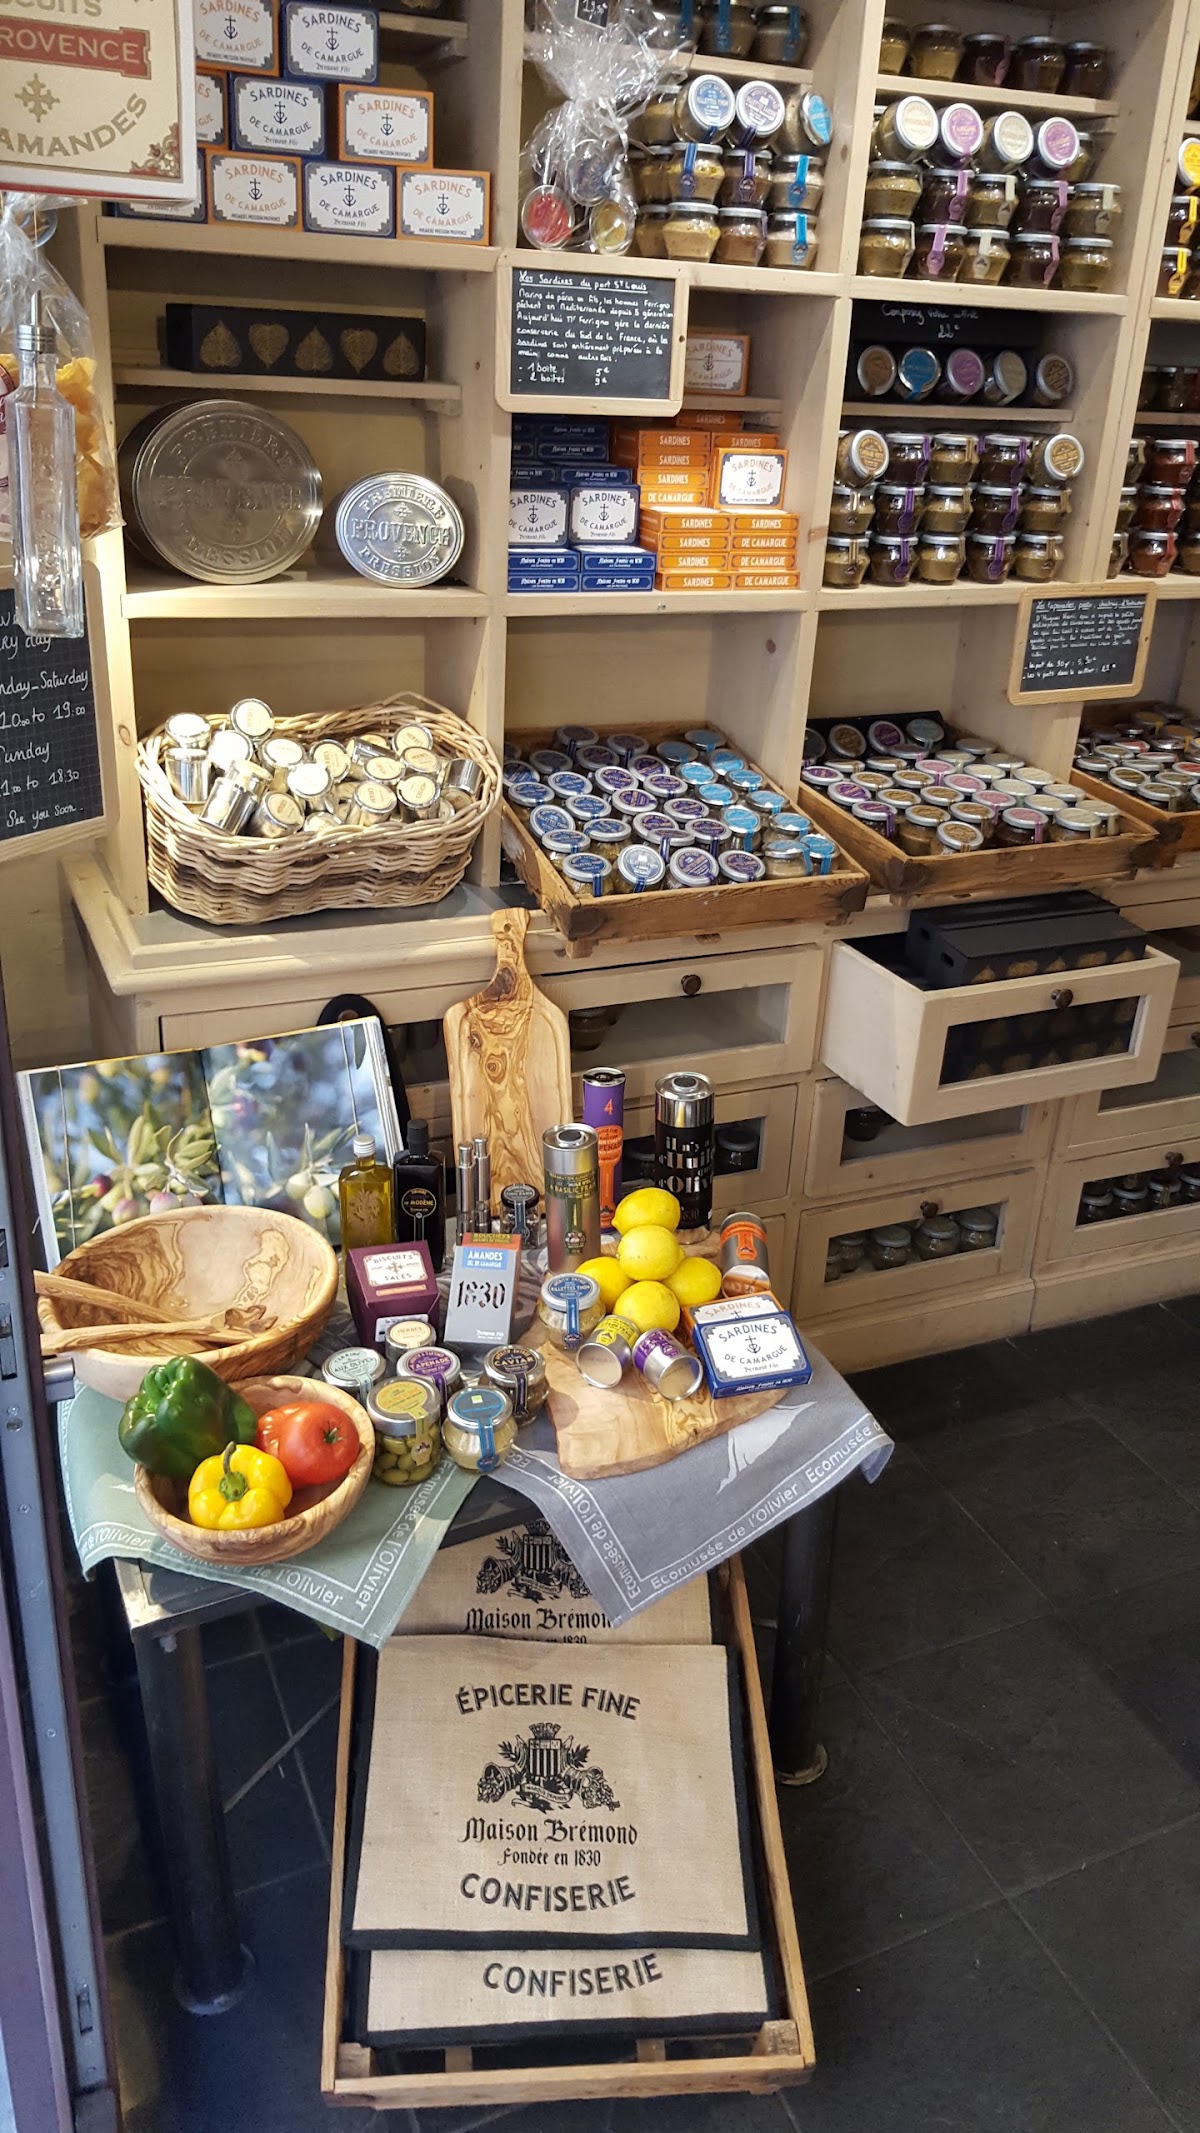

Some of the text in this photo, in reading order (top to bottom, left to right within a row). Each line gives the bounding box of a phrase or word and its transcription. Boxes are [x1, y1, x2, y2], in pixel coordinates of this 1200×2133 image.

[200, 0, 261, 23] SARDINES
[302, 12, 362, 34] SARDINES
[199, 30, 263, 52] DE CAMARGUE
[301, 41, 365, 63] DE CAMARGUE
[250, 87, 309, 107] SARDINES
[358, 100, 416, 120] SARDINES
[249, 115, 312, 137] DE CAMARGUE
[356, 128, 418, 149] DE CAMARGUE
[225, 164, 284, 184] SARDINES
[320, 171, 378, 190] SARDINES
[414, 180, 472, 198] SARDINES
[224, 193, 287, 213] DE CAMARGUE
[319, 199, 380, 219] DE CAMARGUE
[412, 208, 474, 227] DE CAMARGUE
[659, 435, 691, 446] SARDINES
[731, 437, 762, 448] SARDINES
[659, 455, 690, 466] SARDINES
[731, 459, 774, 473] SARDINES
[657, 473, 689, 485] SARDINES
[510, 494, 558, 509] SARDINES
[581, 492, 627, 507] SARDINES
[648, 492, 695, 503] DE CAMARGUE
[351, 518, 451, 547] PROVENCE
[518, 519, 558, 533] CAMARGUE
[580, 516, 628, 531] DE CAMARGUE
[681, 518, 713, 529] SARDINES
[751, 518, 782, 529] SARDINES
[679, 537, 711, 548] SARDINES
[741, 538, 787, 548] DE CAMARGUE
[677, 556, 709, 567] SARDINES
[740, 556, 786, 566] DE CAMARGUE
[683, 576, 714, 587] SARDINES
[744, 576, 790, 586] DE CAMARGUE
[32, 707, 46, 722] to
[26, 775, 39, 790] to
[6, 809, 50, 829] See you
[603, 1098, 614, 1116] 4
[373, 1253, 414, 1264] BISCUITS
[467, 1250, 503, 1260] AMANDES
[456, 1280, 506, 1309] 1830
[705, 1301, 761, 1317] SARDINES
[718, 1323, 778, 1343] SARDINES
[408, 1356, 450, 1370] TAPENADE
[494, 1356, 534, 1366] CAVIAR
[724, 1344, 788, 1365] DE CAMARGUE
[334, 1363, 350, 1373] AUX
[651, 1424, 872, 1591] Ecomusée de l'Olivier Ecomusée
[392, 1521, 412, 1539] de
[546, 1474, 642, 1600] Ecomusée de l'Olivier
[355, 1539, 402, 1611] l'Olivier
[275, 1569, 344, 1606] l'Olivier
[461, 1607, 532, 1633] Maison
[455, 1682, 641, 1721] ÉPICERIE FINE
[457, 1816, 638, 1846] Maison Brémond
[497, 1847, 601, 1867] Fondée en 1830
[460, 1872, 636, 1913] CONFISERIE
[482, 1953, 663, 1998] CONFISERIE
